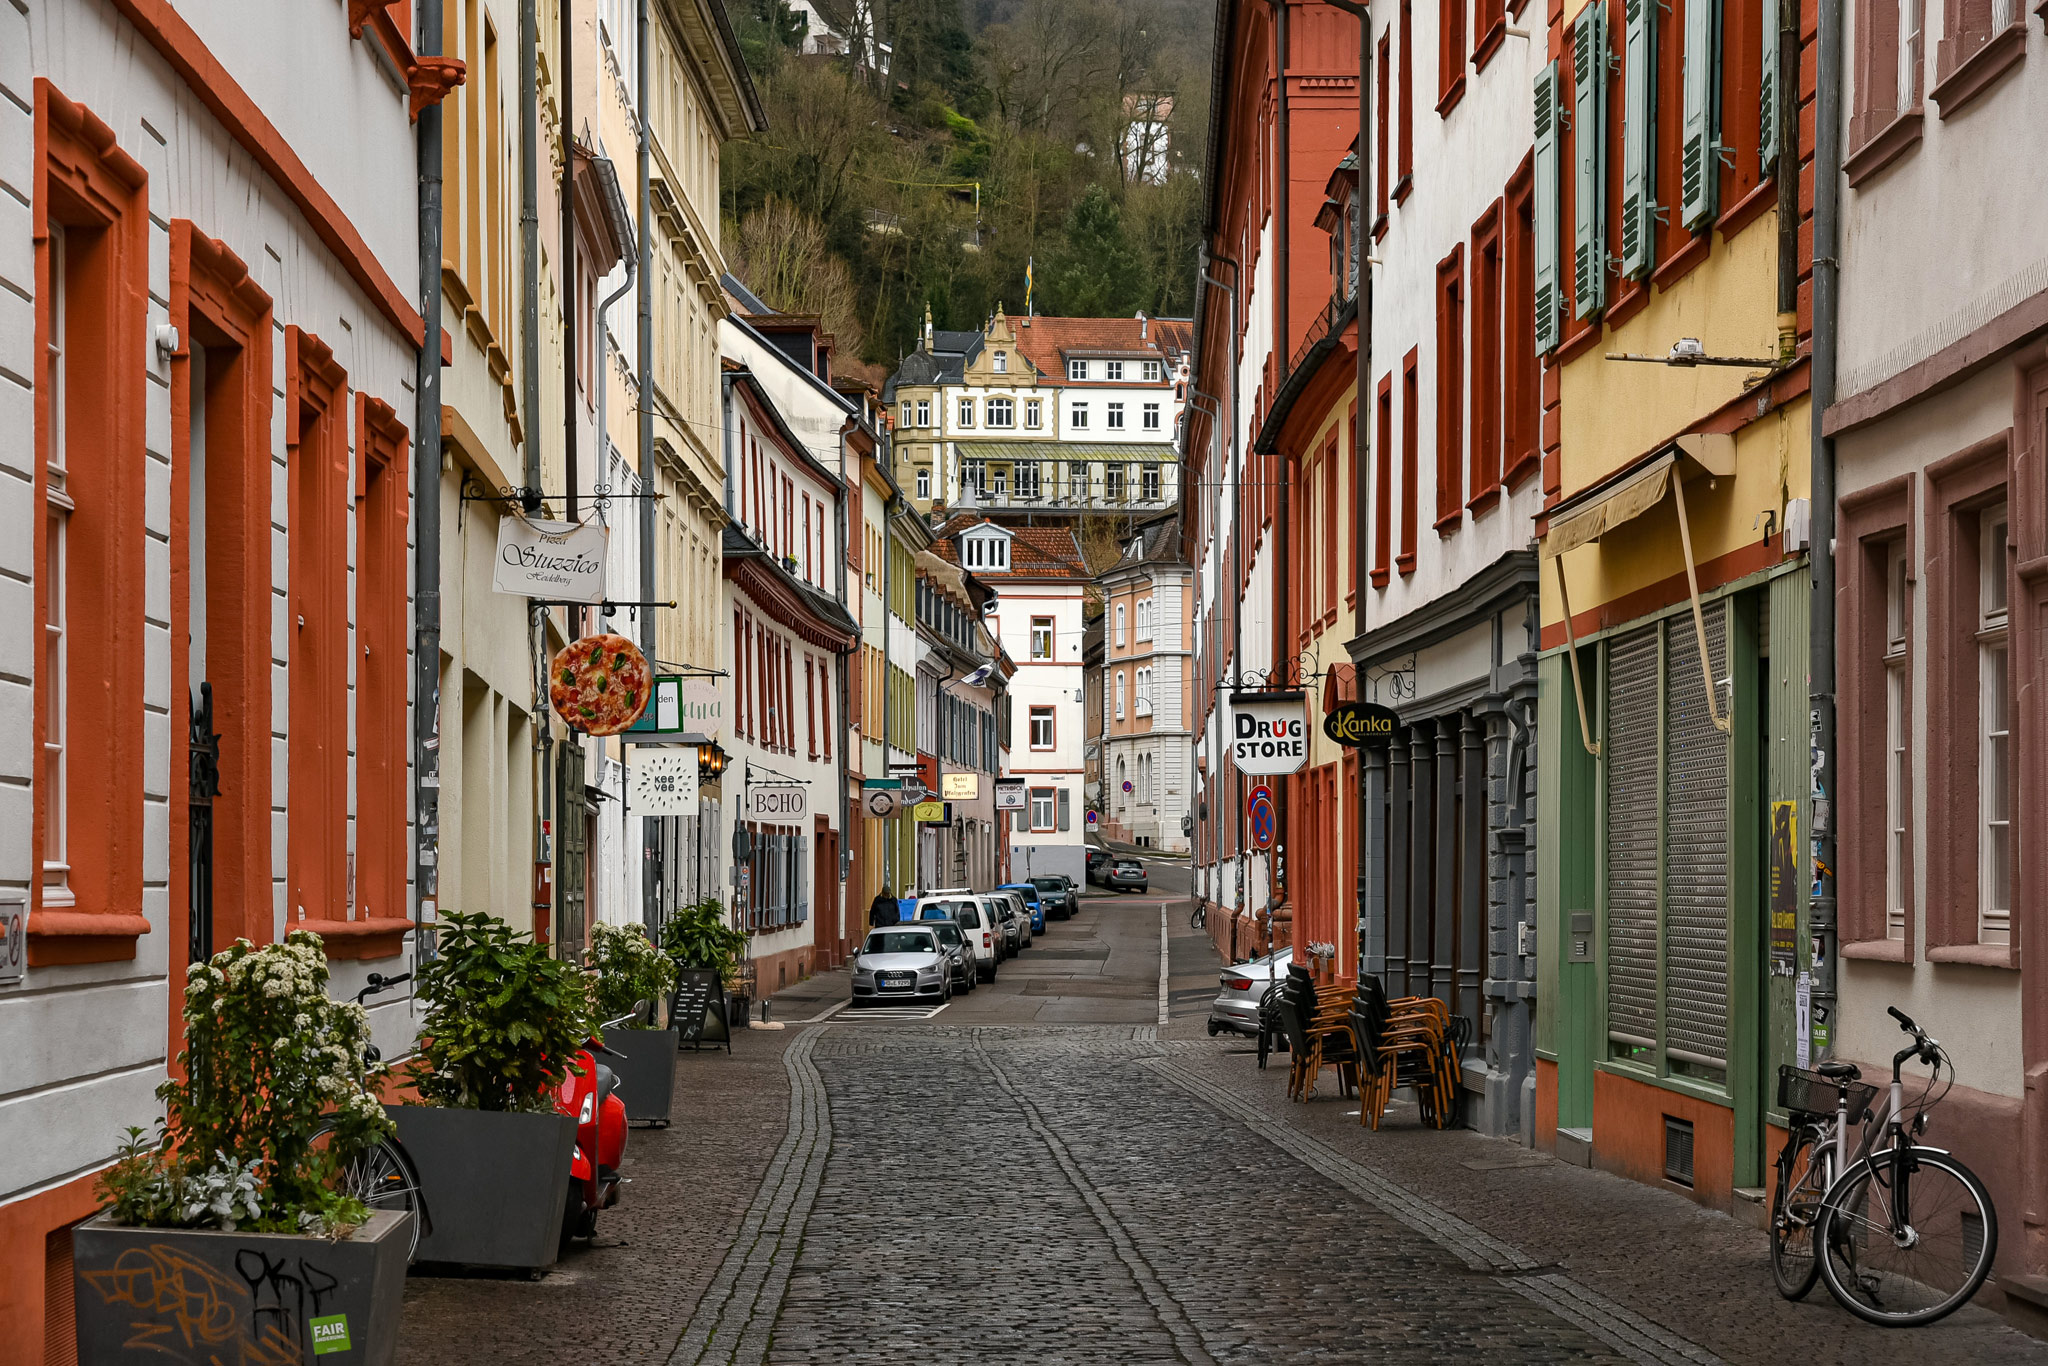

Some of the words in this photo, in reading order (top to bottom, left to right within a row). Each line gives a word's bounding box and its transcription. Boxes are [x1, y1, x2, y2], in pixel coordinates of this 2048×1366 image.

[539, 533, 568, 545] Pizza
[503, 543, 600, 574] Stuzzico
[526, 571, 573, 587] Heidelberg
[1331, 710, 1392, 741] Kanka
[1236, 740, 1303, 759] STORE
[755, 793, 803, 813] BOHO
[313, 1322, 345, 1337] FAIR
